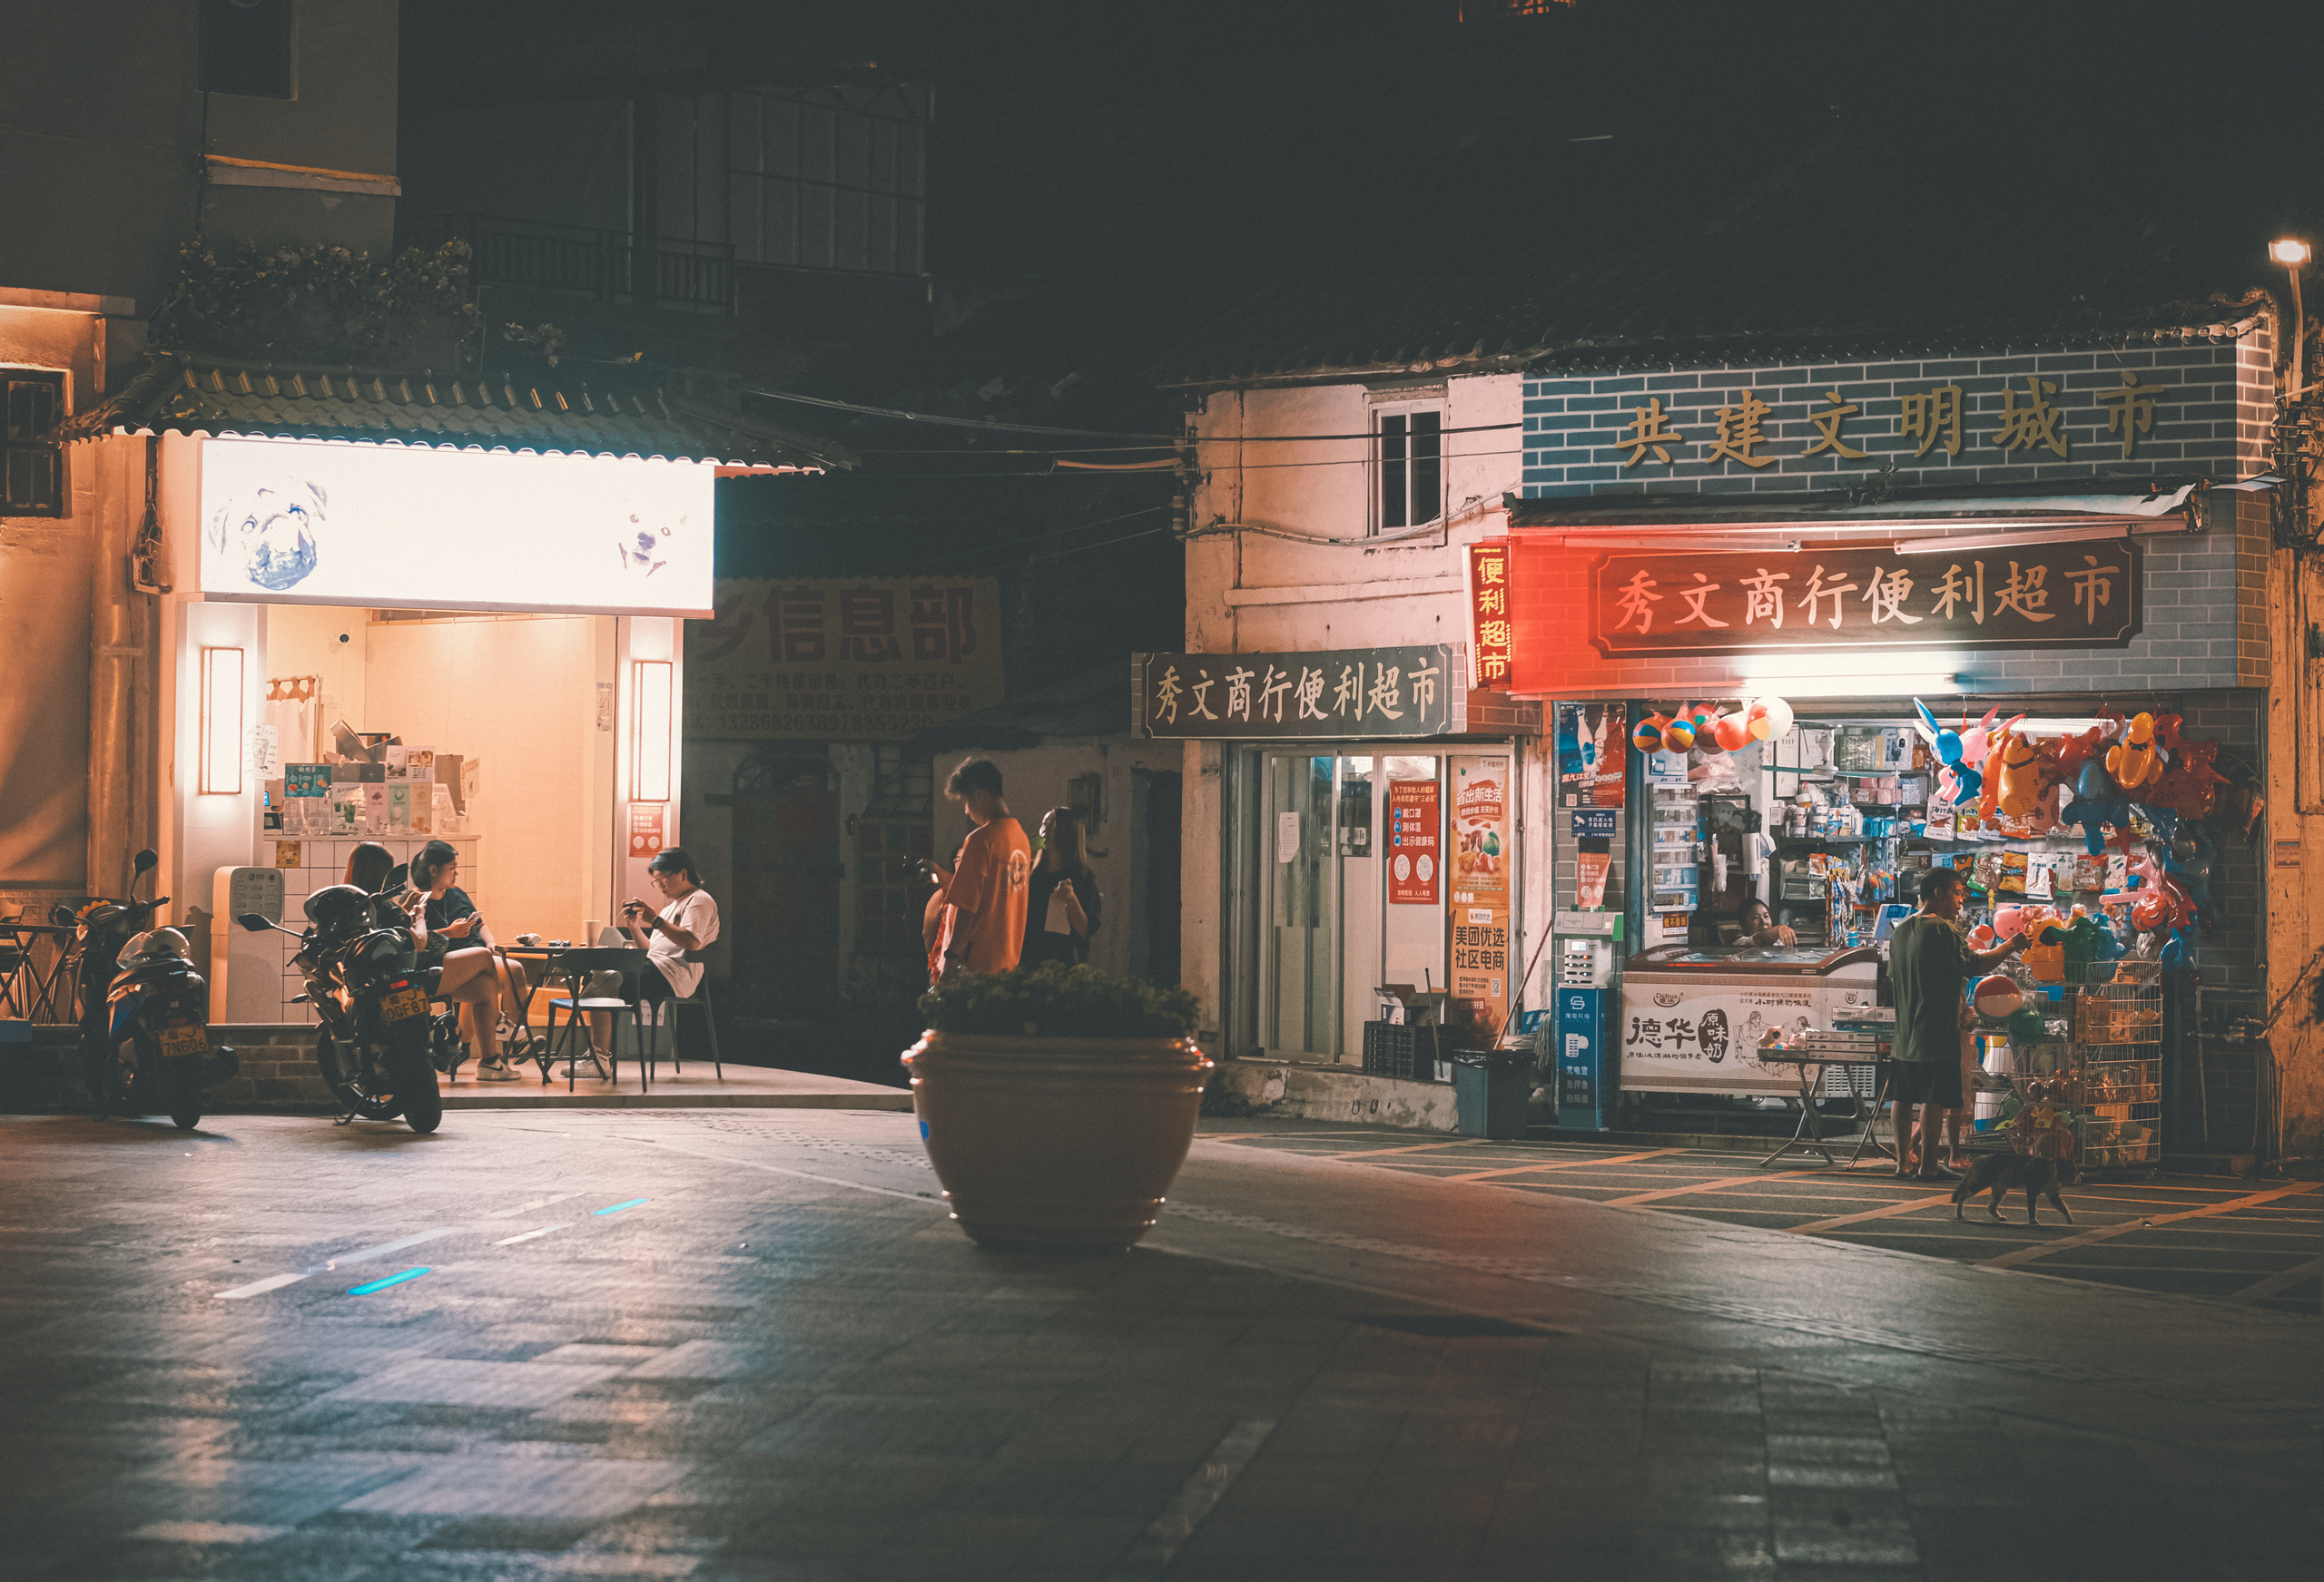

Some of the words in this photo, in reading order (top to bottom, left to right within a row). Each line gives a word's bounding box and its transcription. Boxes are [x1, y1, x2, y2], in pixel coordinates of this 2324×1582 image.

[1614, 371, 2167, 468] 共建文明城市
[1614, 555, 2121, 635] 秀文商行便利超市
[1478, 556, 1509, 680] 便利超市
[1155, 656, 1440, 725] 秀文商行便利超市
[1456, 787, 1503, 807] 省出新生活
[1403, 808, 1422, 819] 戴口罩
[1402, 821, 1422, 832] 测体温
[1402, 836, 1435, 847] 出示健康码
[1455, 926, 1505, 948] 美团优选
[1455, 948, 1505, 971] 社区电商
[1755, 998, 1812, 1007] 小时候的味道
[1625, 1016, 1697, 1050] 德华
[1701, 1009, 1728, 1060] 原味奶
[1566, 1065, 1589, 1076] 充电宝
